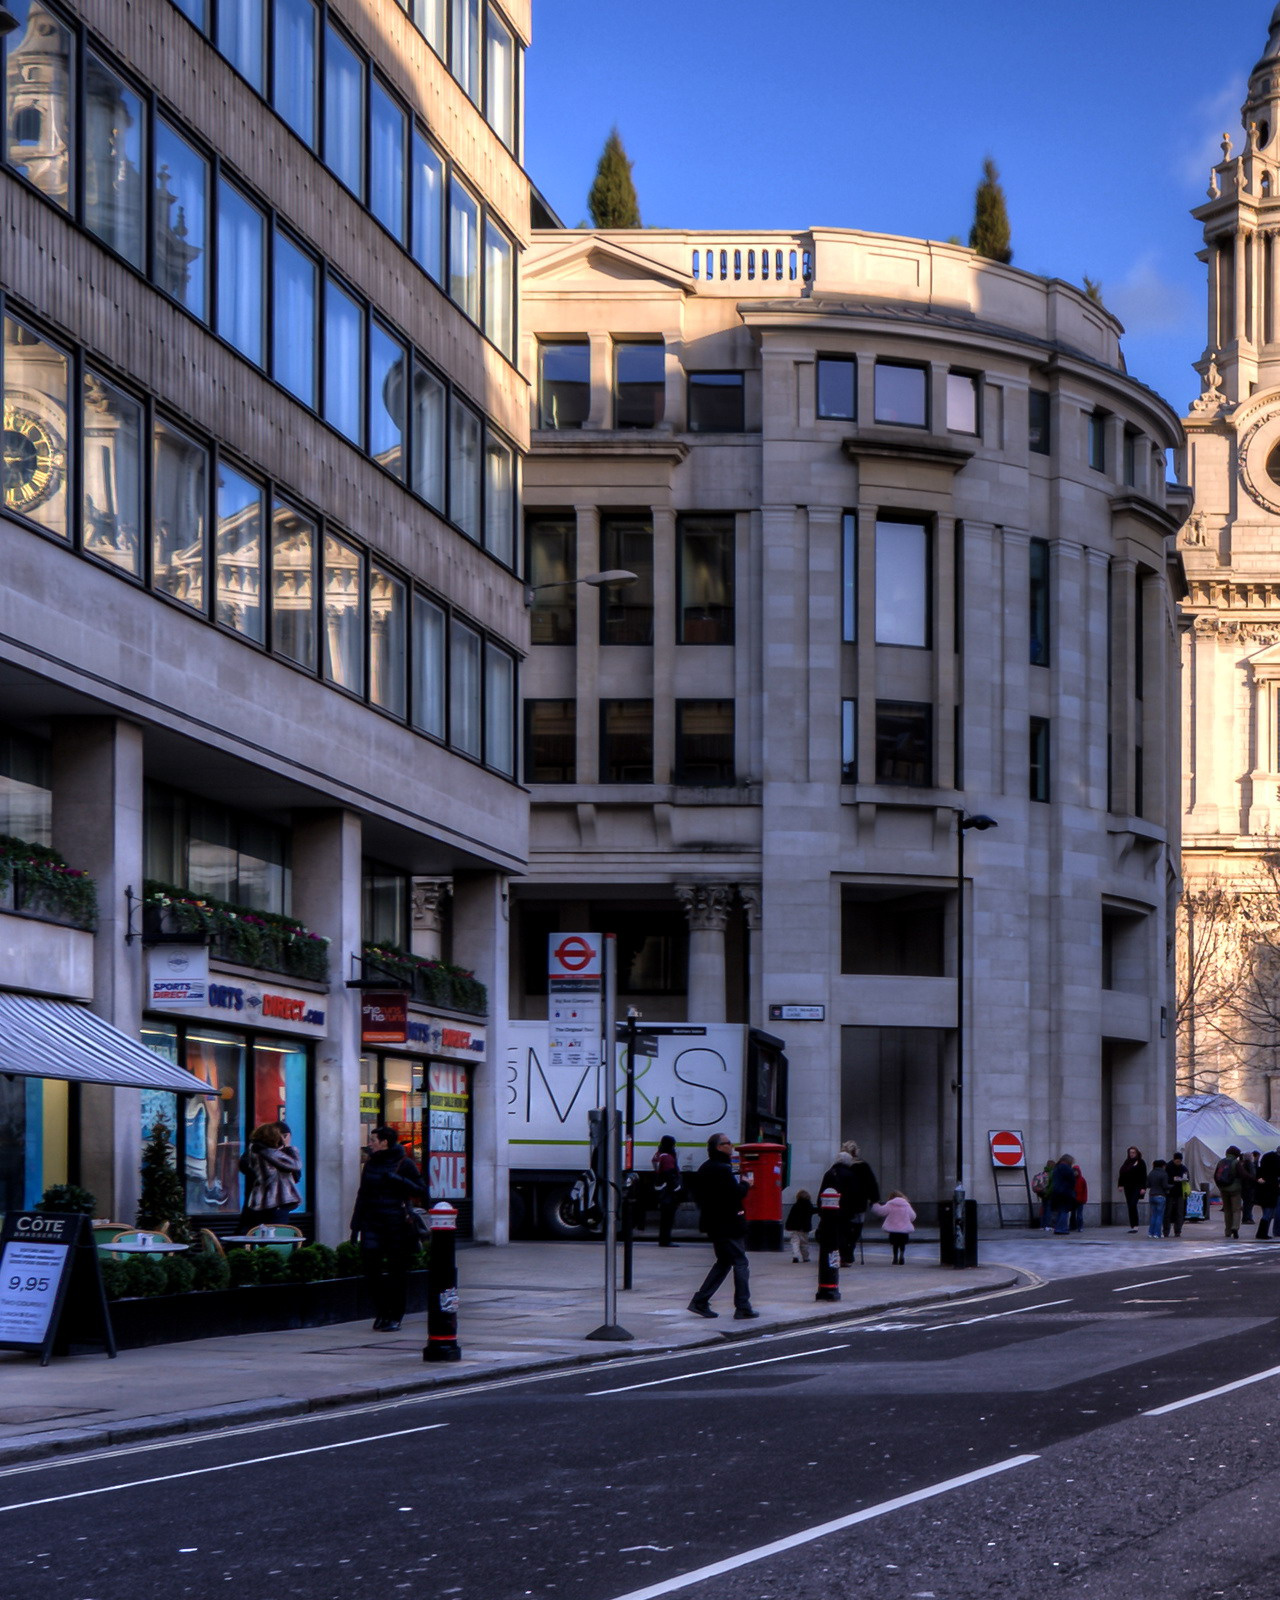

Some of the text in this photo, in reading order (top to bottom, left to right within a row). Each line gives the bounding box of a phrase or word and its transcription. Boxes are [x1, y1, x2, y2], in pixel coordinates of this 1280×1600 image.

[153, 983, 192, 991] SPORTS
[209, 983, 244, 1011] ORTS
[429, 1156, 466, 1199] SALE
[17, 1216, 65, 1232] CÔTE
